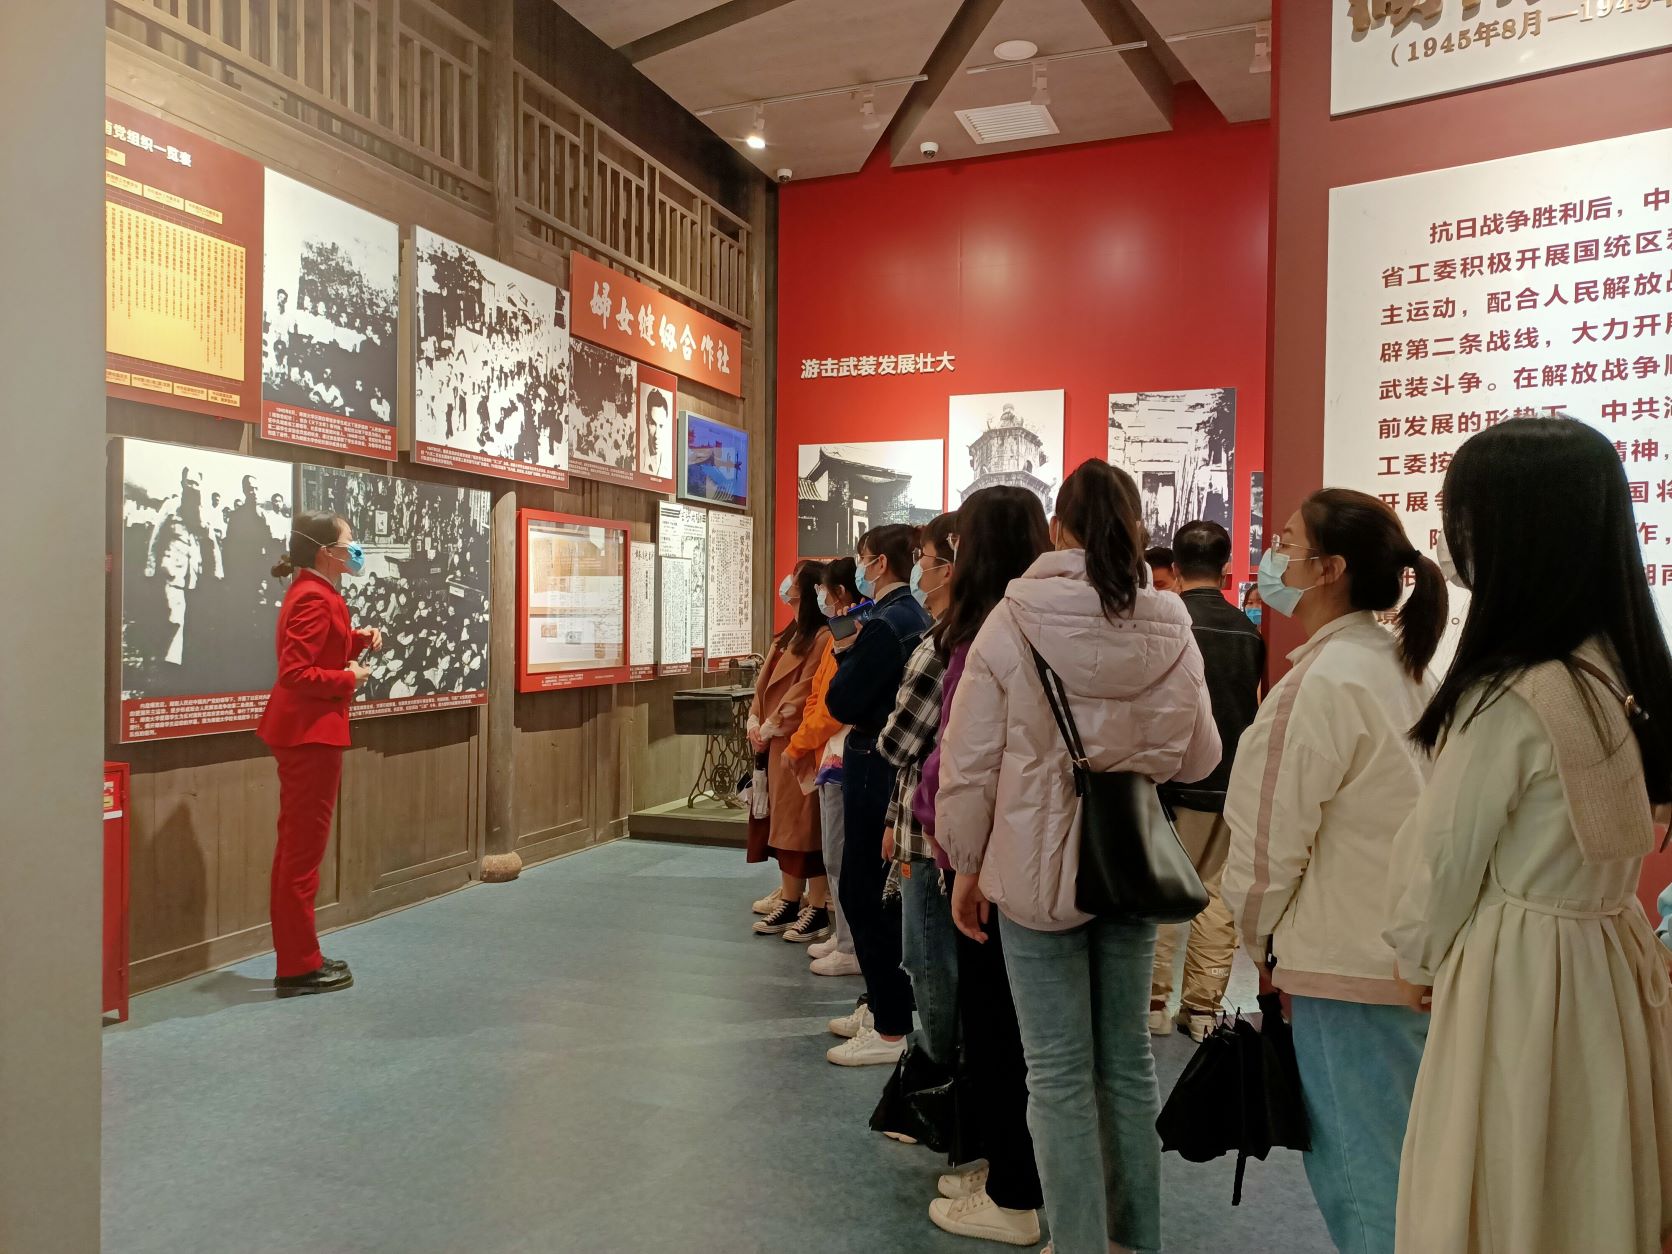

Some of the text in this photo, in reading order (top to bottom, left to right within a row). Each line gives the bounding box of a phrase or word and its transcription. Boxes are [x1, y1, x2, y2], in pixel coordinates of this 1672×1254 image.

[1381, 228, 1672, 289] 省工委积极开展国统区
[1380, 269, 1672, 326] 主运动，配合人民解放
[1379, 311, 1672, 363] 辟第二条战线，大力开
[800, 351, 956, 379] 游击武装发展壮大
[1379, 353, 1672, 400] 武装斗争。在解放战争
[1377, 451, 1454, 476] 工委按
